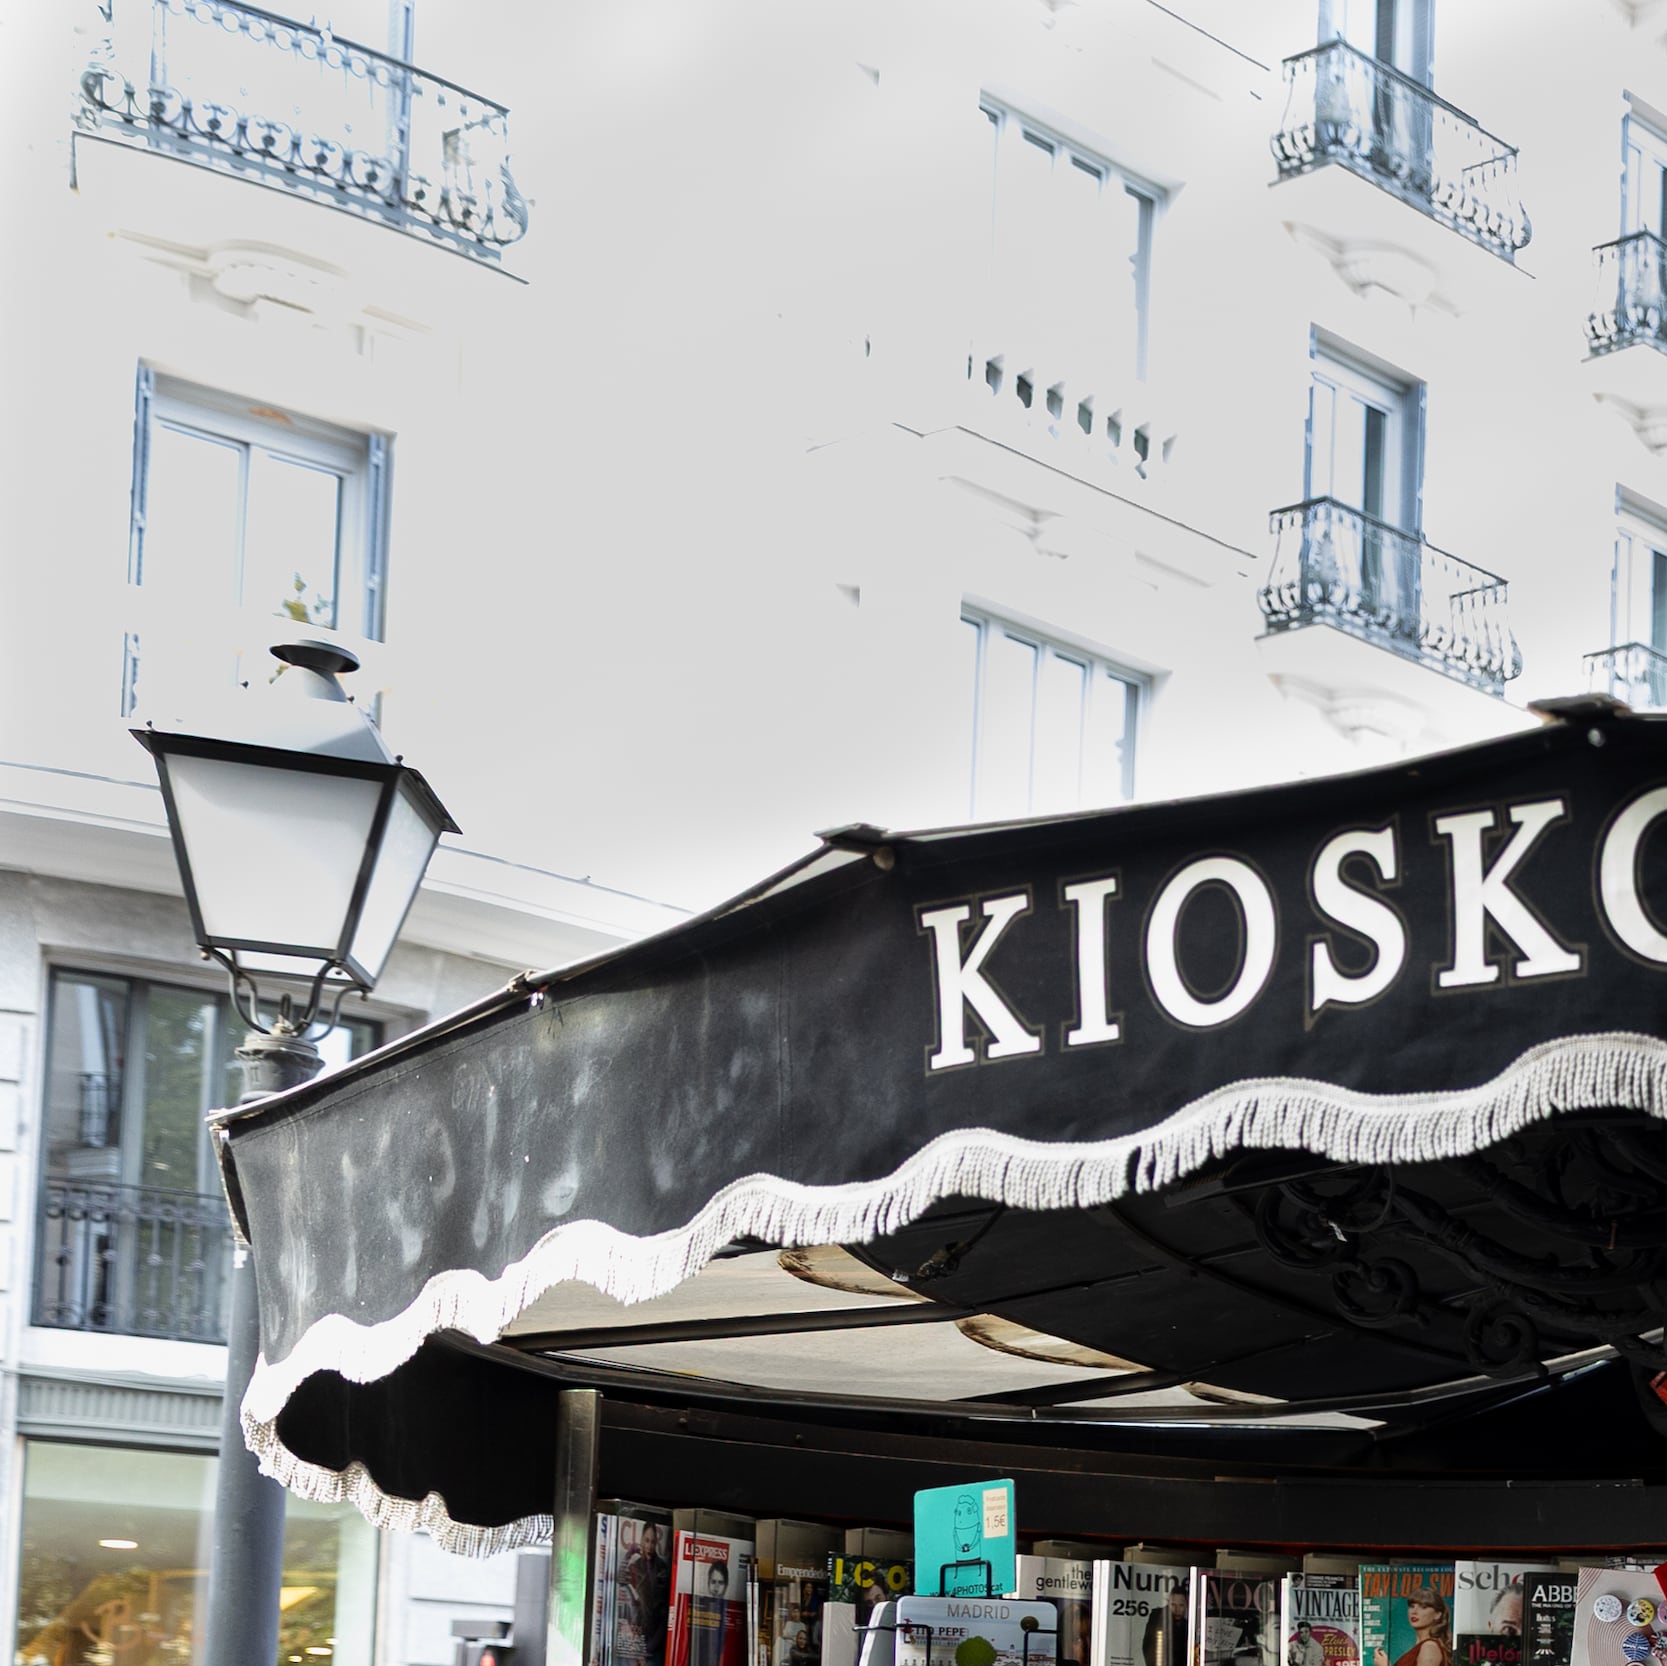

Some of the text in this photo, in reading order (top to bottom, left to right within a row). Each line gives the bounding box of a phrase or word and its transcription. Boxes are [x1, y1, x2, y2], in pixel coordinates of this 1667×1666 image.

[1072, 1566, 1089, 1579] the
[946, 1603, 1011, 1620] MADRID
[1113, 1599, 1149, 1616] 256
[939, 1626, 966, 1638] PEPE
